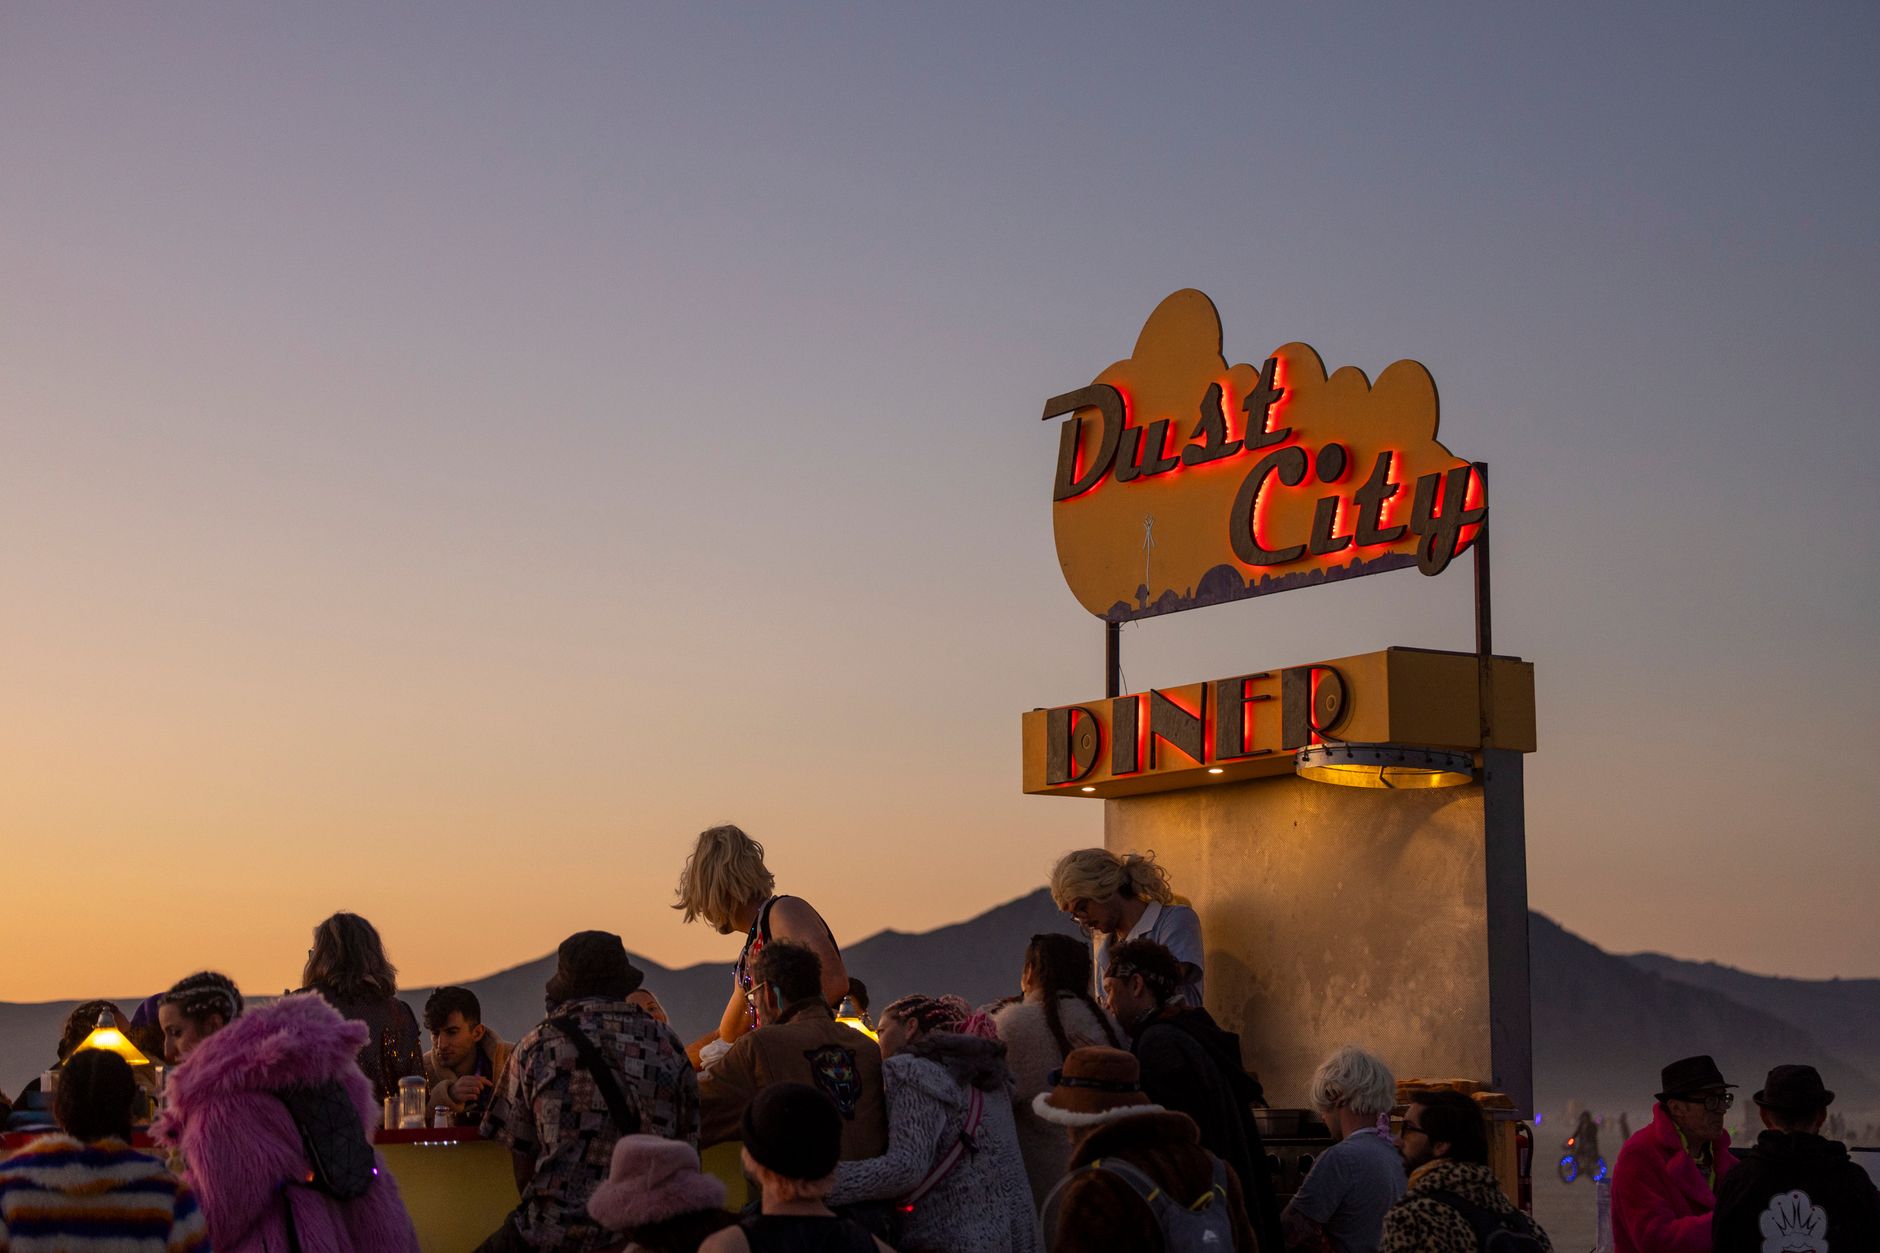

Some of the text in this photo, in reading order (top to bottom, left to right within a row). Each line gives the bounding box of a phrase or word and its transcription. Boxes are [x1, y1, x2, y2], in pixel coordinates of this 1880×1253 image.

[1042, 357, 1292, 501] Dust
[1229, 443, 1488, 576] City
[1040, 664, 1347, 785] DINER
